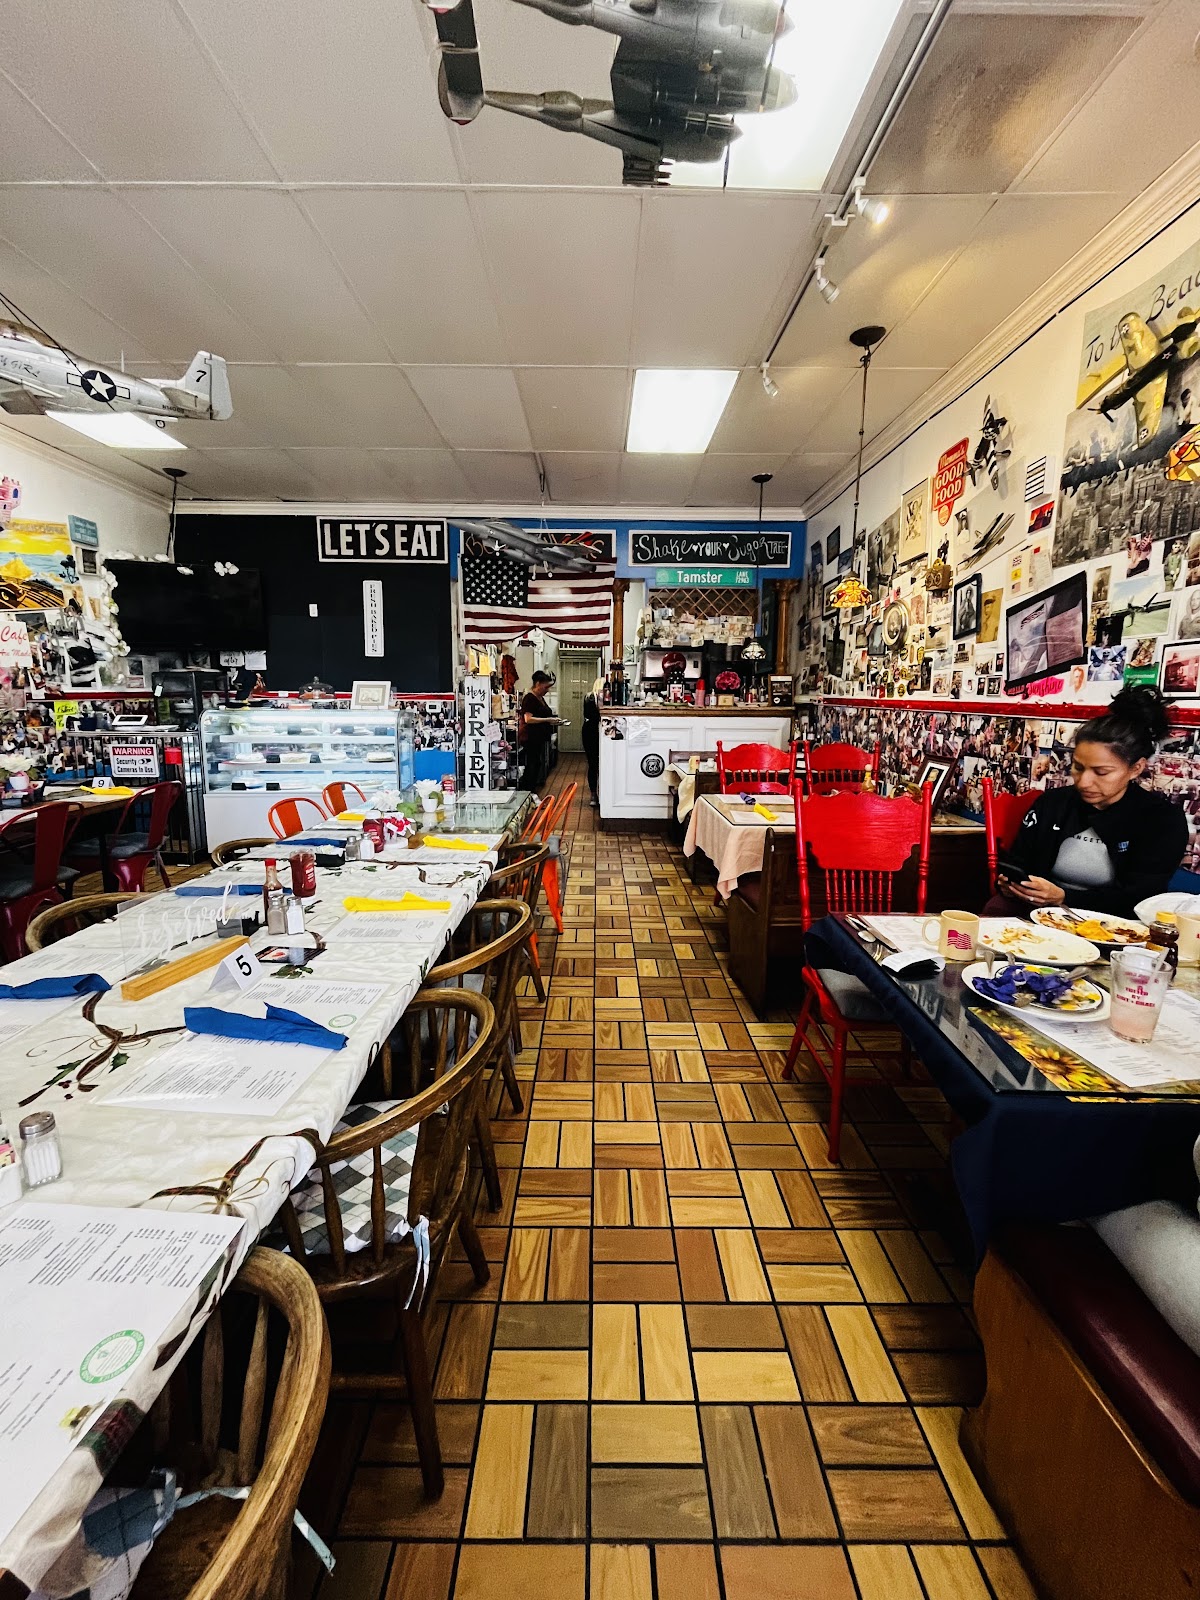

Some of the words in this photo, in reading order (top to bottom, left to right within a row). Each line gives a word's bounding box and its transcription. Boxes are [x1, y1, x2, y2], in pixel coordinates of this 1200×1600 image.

[1085, 335, 1105, 369] To
[195, 369, 208, 383] 7
[935, 461, 964, 490] GOOD
[934, 479, 962, 506] FOOD
[323, 522, 390, 556] LET'S
[394, 524, 442, 557] EAT
[698, 541, 722, 557] YOUR
[676, 570, 723, 584] Tamster
[466, 685, 487, 702] Hey
[114, 747, 152, 755] WARNING
[116, 757, 137, 766] Security
[97, 779, 105, 788] 9
[126, 881, 240, 965] reserved
[235, 954, 253, 977] 5
